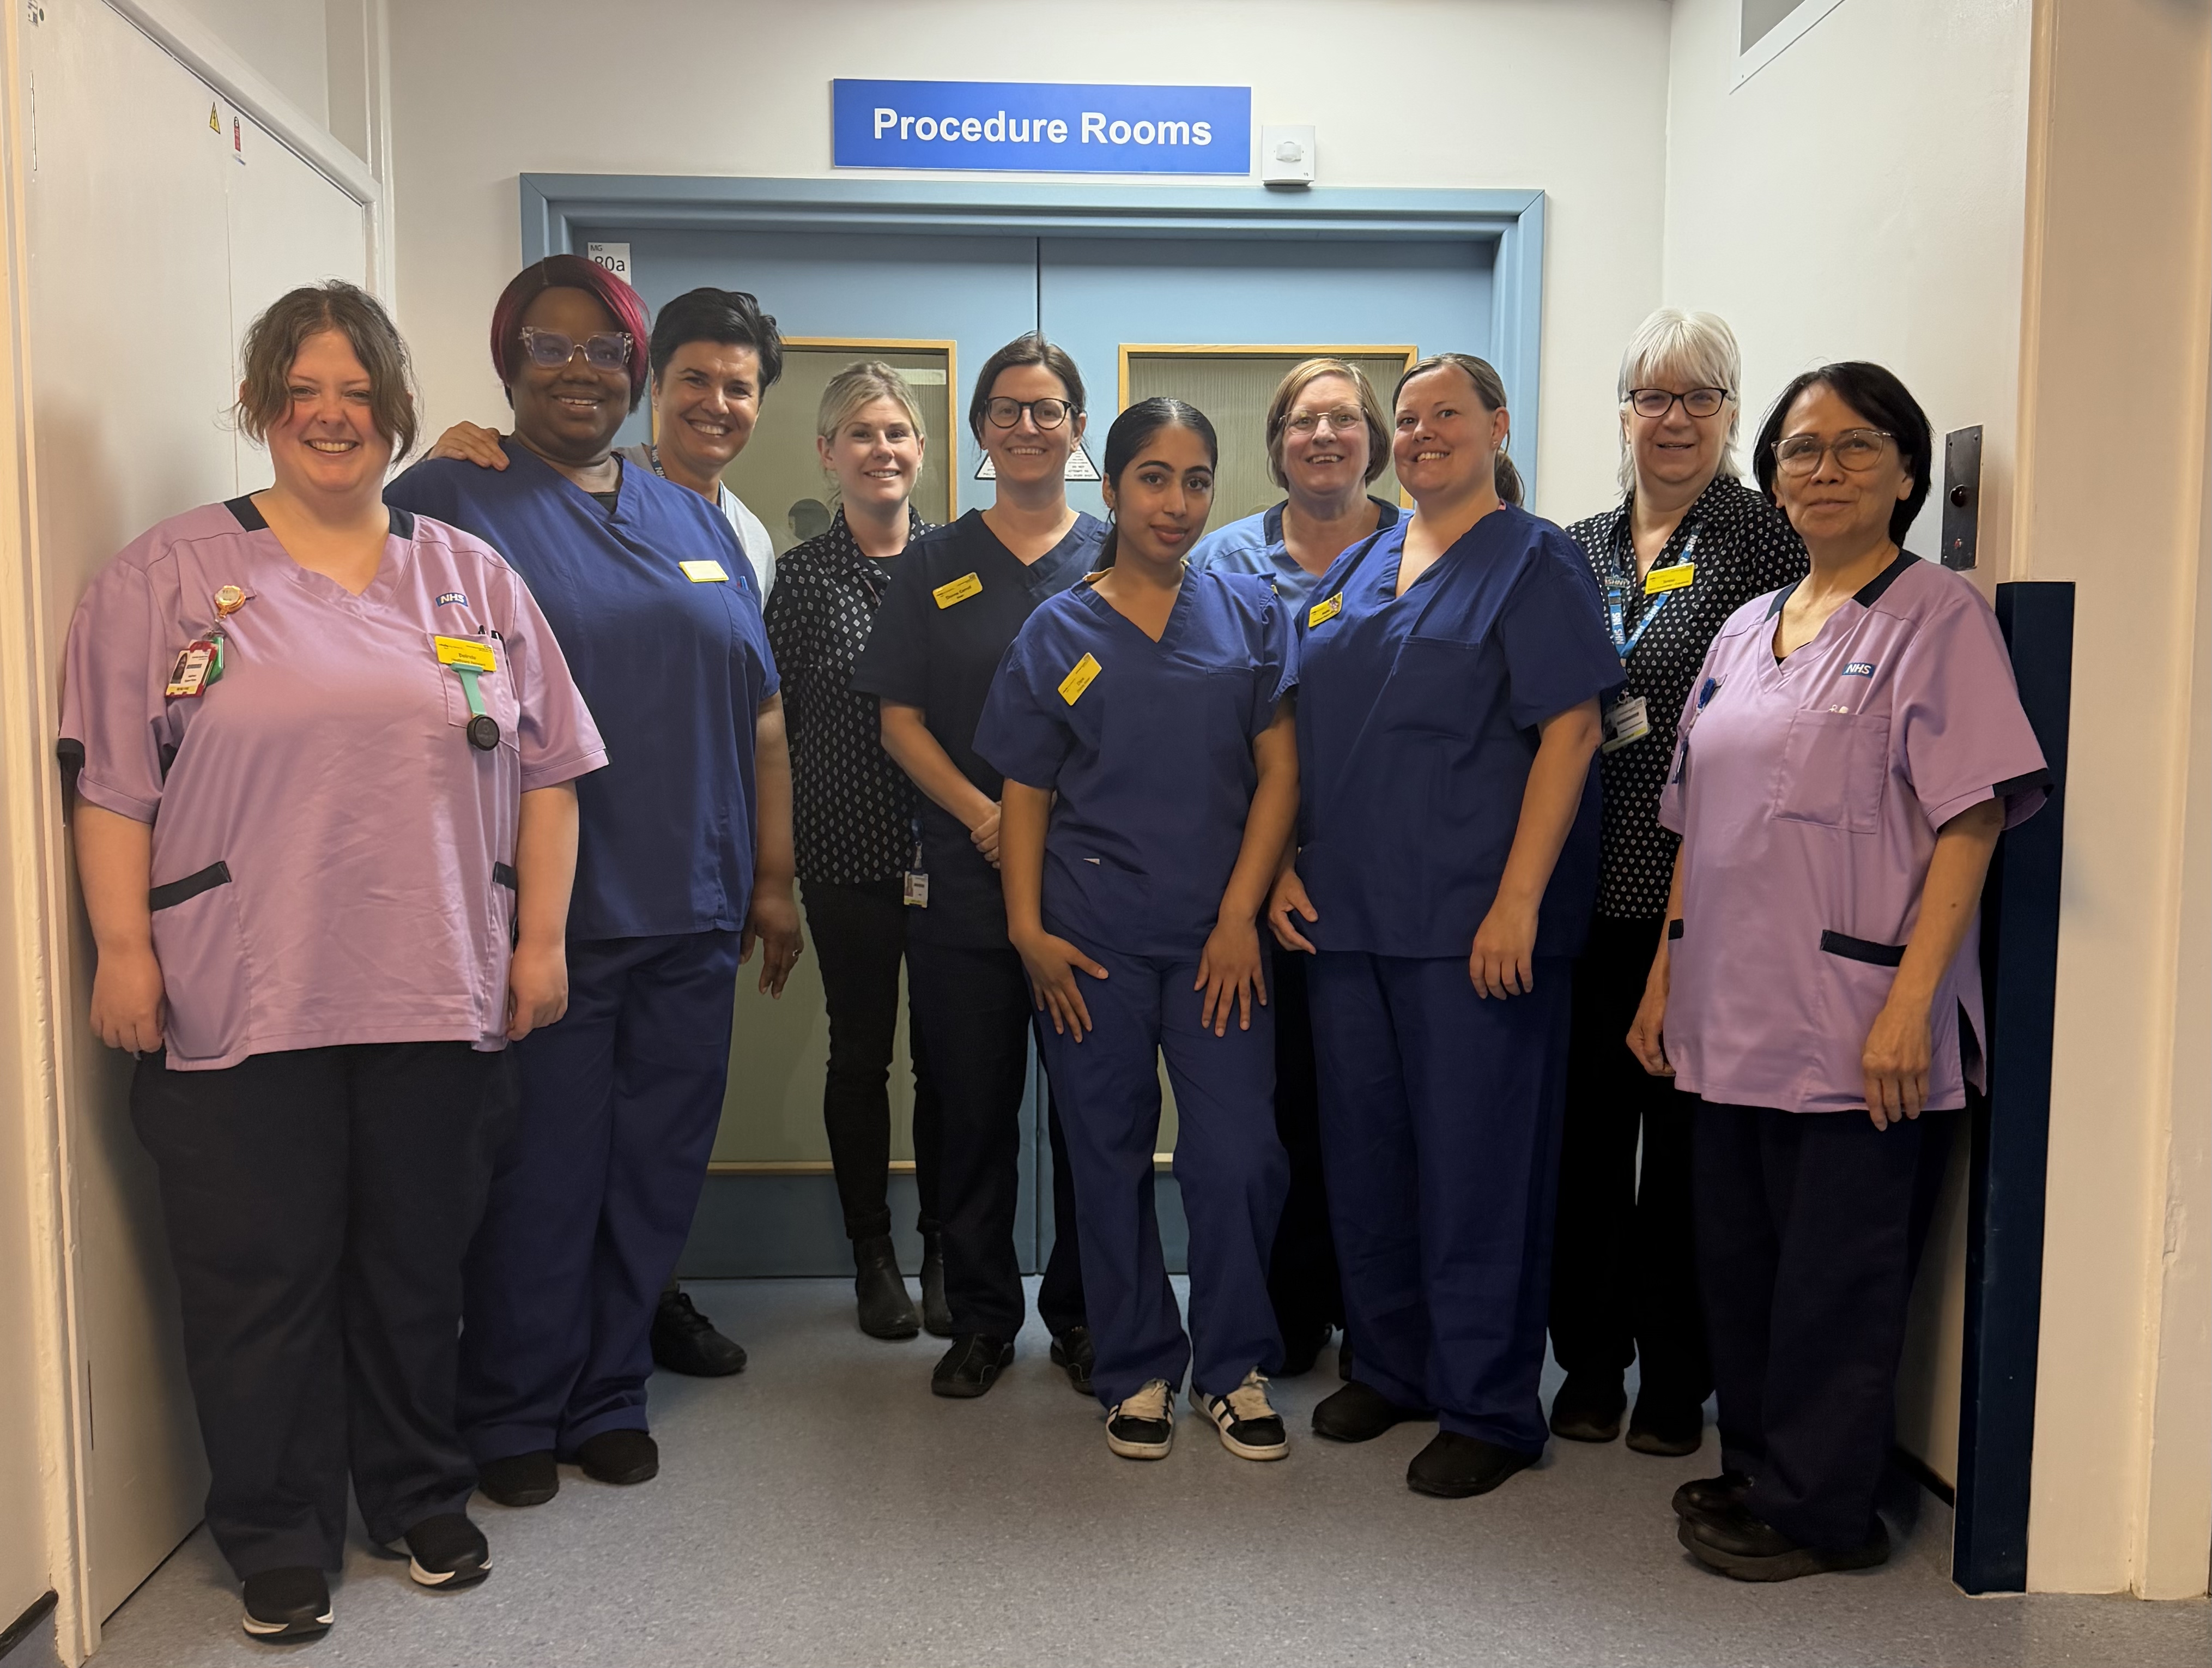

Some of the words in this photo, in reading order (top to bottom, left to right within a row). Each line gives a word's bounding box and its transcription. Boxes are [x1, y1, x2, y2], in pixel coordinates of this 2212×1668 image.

[874, 108, 1068, 144] Procedure
[1081, 112, 1213, 146] Rooms
[440, 594, 465, 604] NHS
[1845, 663, 1872, 674] NHS
